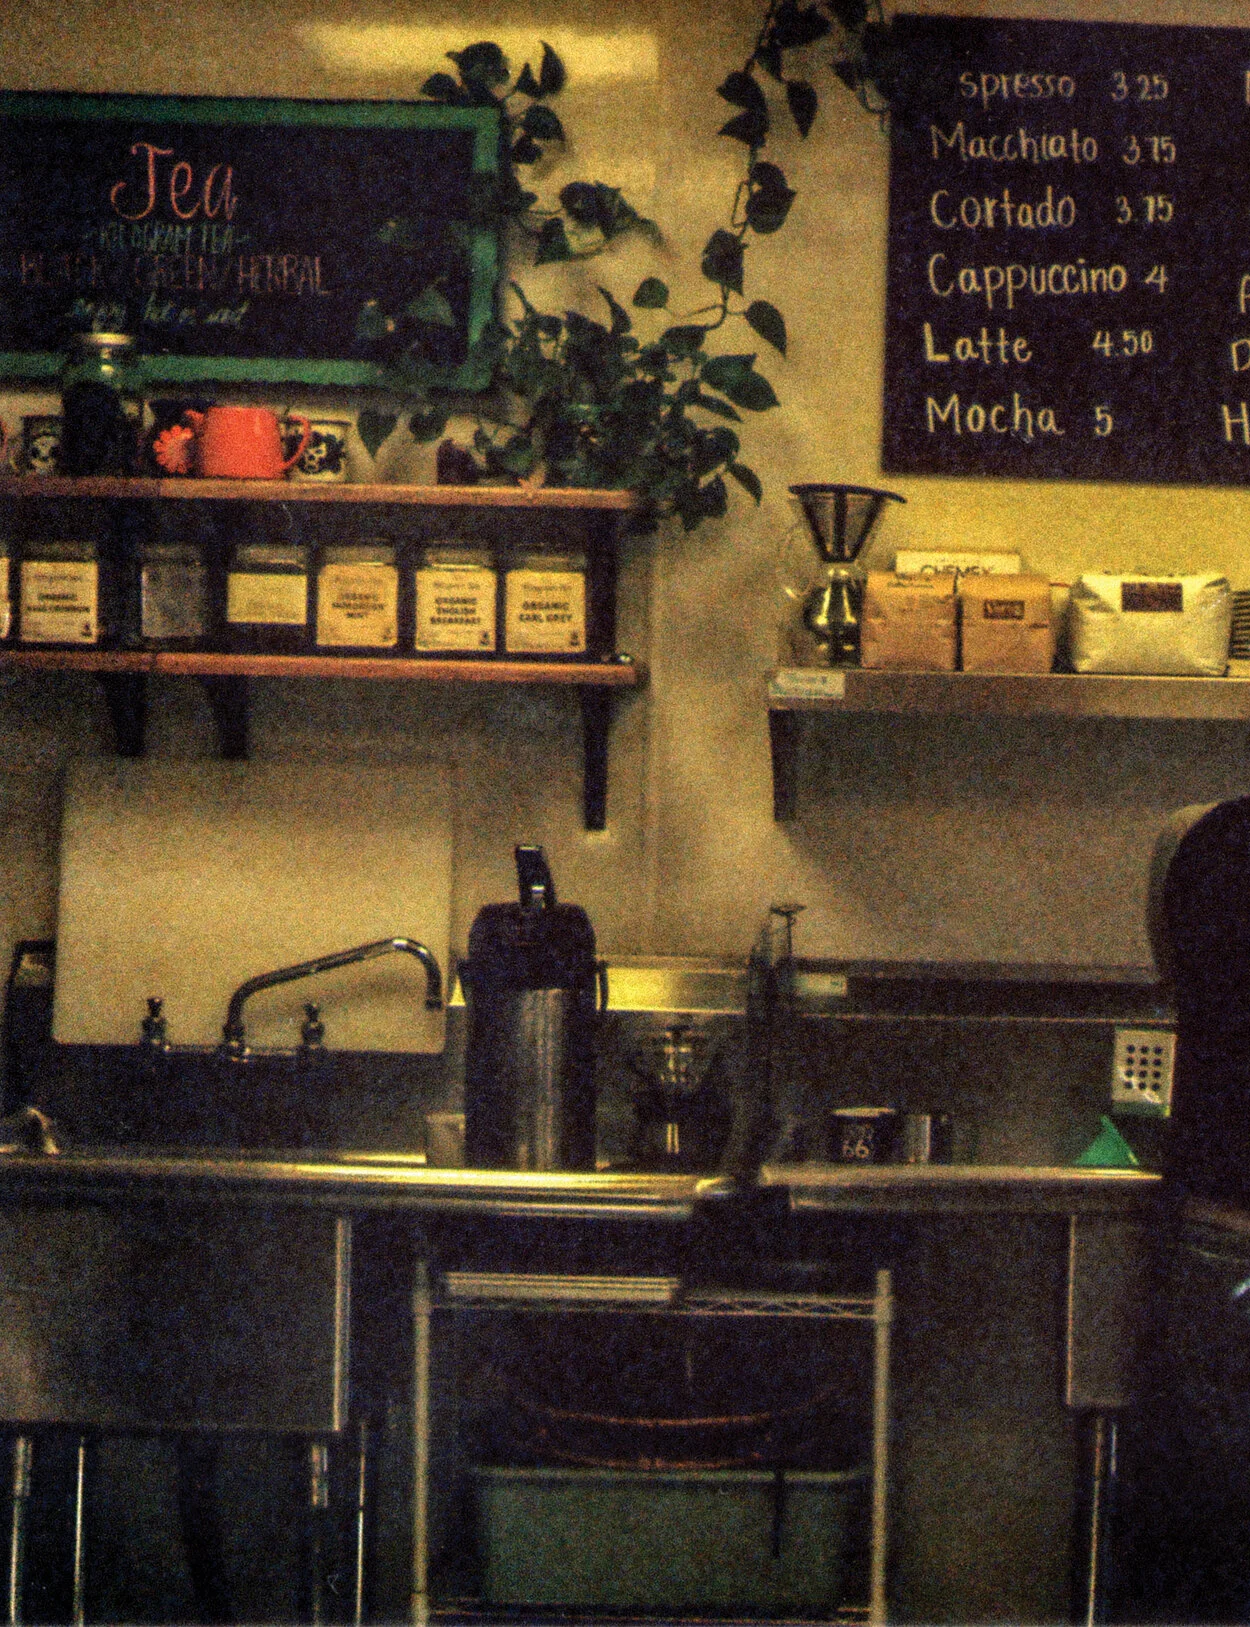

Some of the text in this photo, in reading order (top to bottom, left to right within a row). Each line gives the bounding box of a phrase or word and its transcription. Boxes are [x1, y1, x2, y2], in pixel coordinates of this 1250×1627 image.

[930, 120, 1098, 165] Macchiato
[110, 141, 239, 221] Tea
[930, 186, 1077, 230] Cortado
[927, 253, 1169, 310] Cappuccino 4
[923, 321, 1154, 366] Latte 4.50
[926, 392, 1115, 440] Mocha 5
